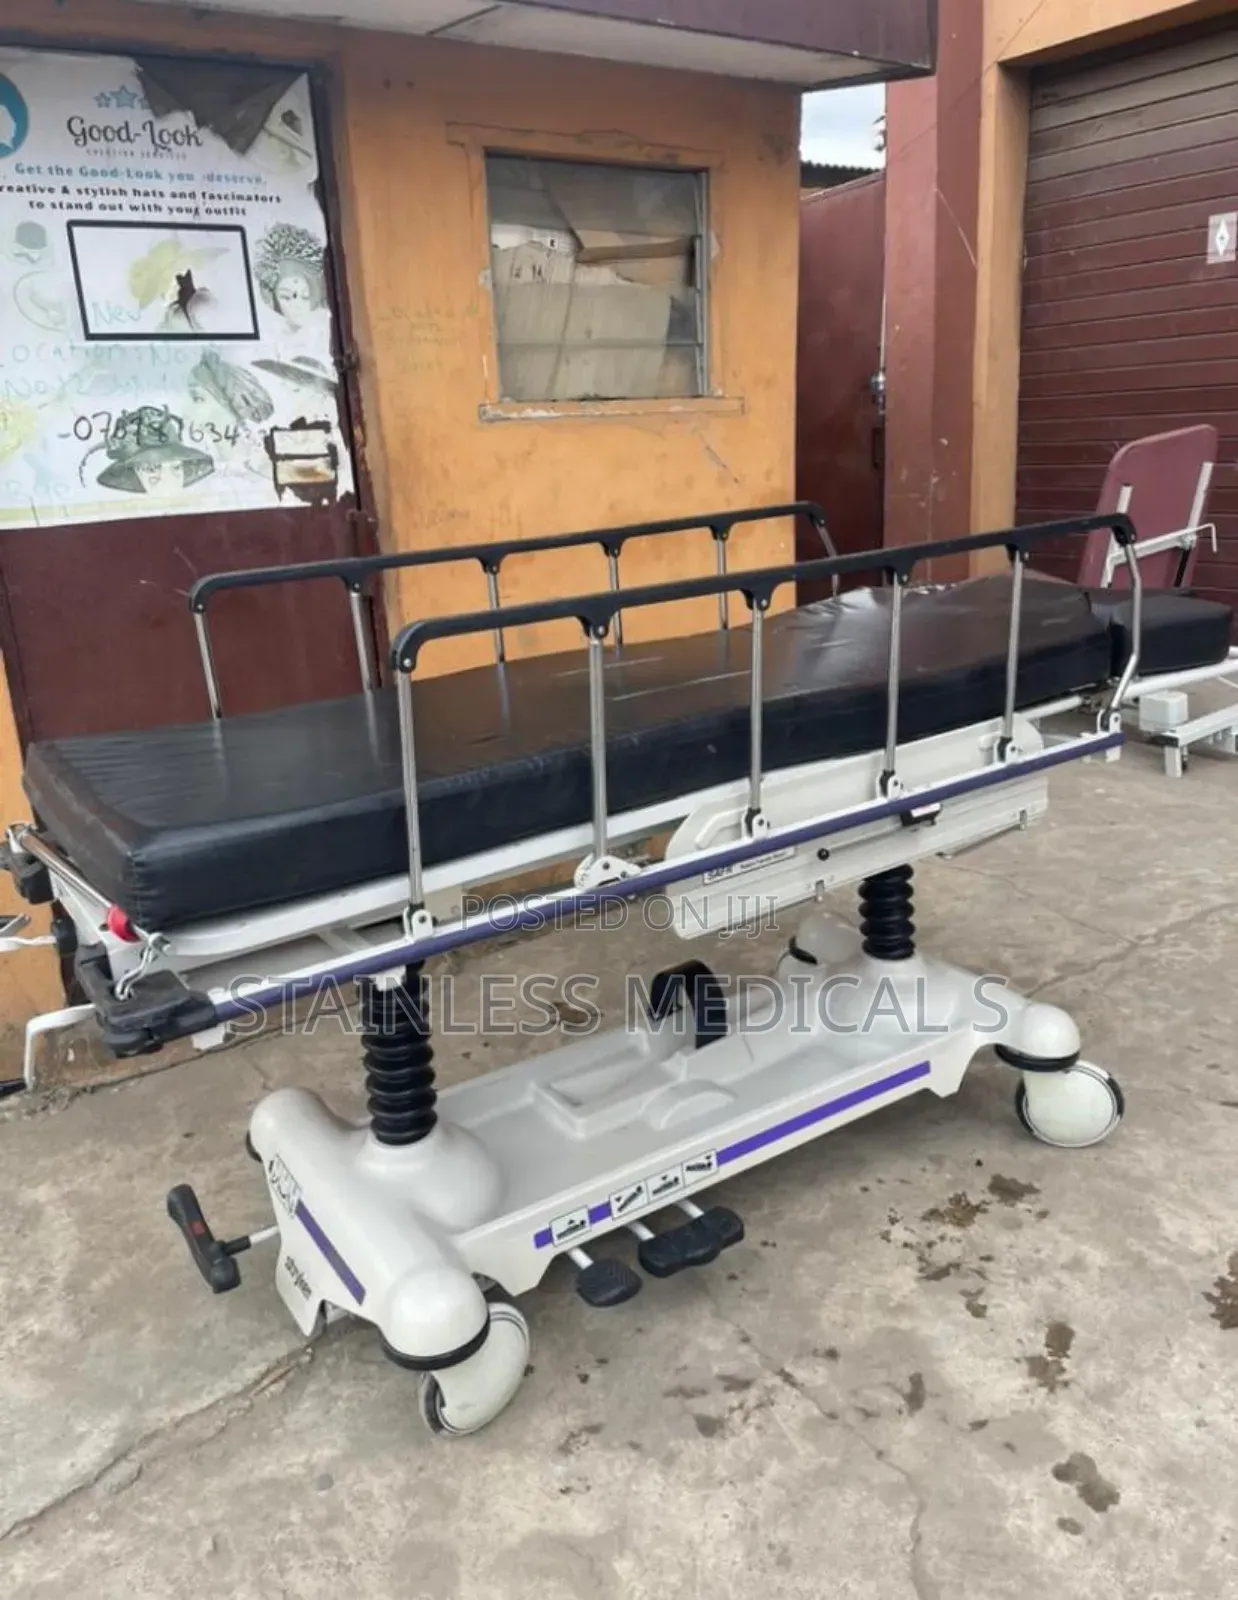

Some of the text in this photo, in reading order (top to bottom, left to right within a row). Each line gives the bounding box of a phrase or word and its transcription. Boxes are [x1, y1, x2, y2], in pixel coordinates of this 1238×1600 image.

[66, 115, 204, 152] Good-Look
[14, 162, 42, 175] Get
[47, 164, 73, 177] the
[168, 172, 195, 184] you
[61, 184, 70, 195] &
[76, 186, 128, 199] stylish
[132, 188, 165, 199] hats
[170, 190, 197, 200] and
[201, 191, 282, 204] fascinators
[28, 199, 46, 210] to
[50, 200, 94, 212] stand
[98, 202, 124, 212] out
[129, 202, 163, 214] with
[204, 206, 247, 217] outfit
